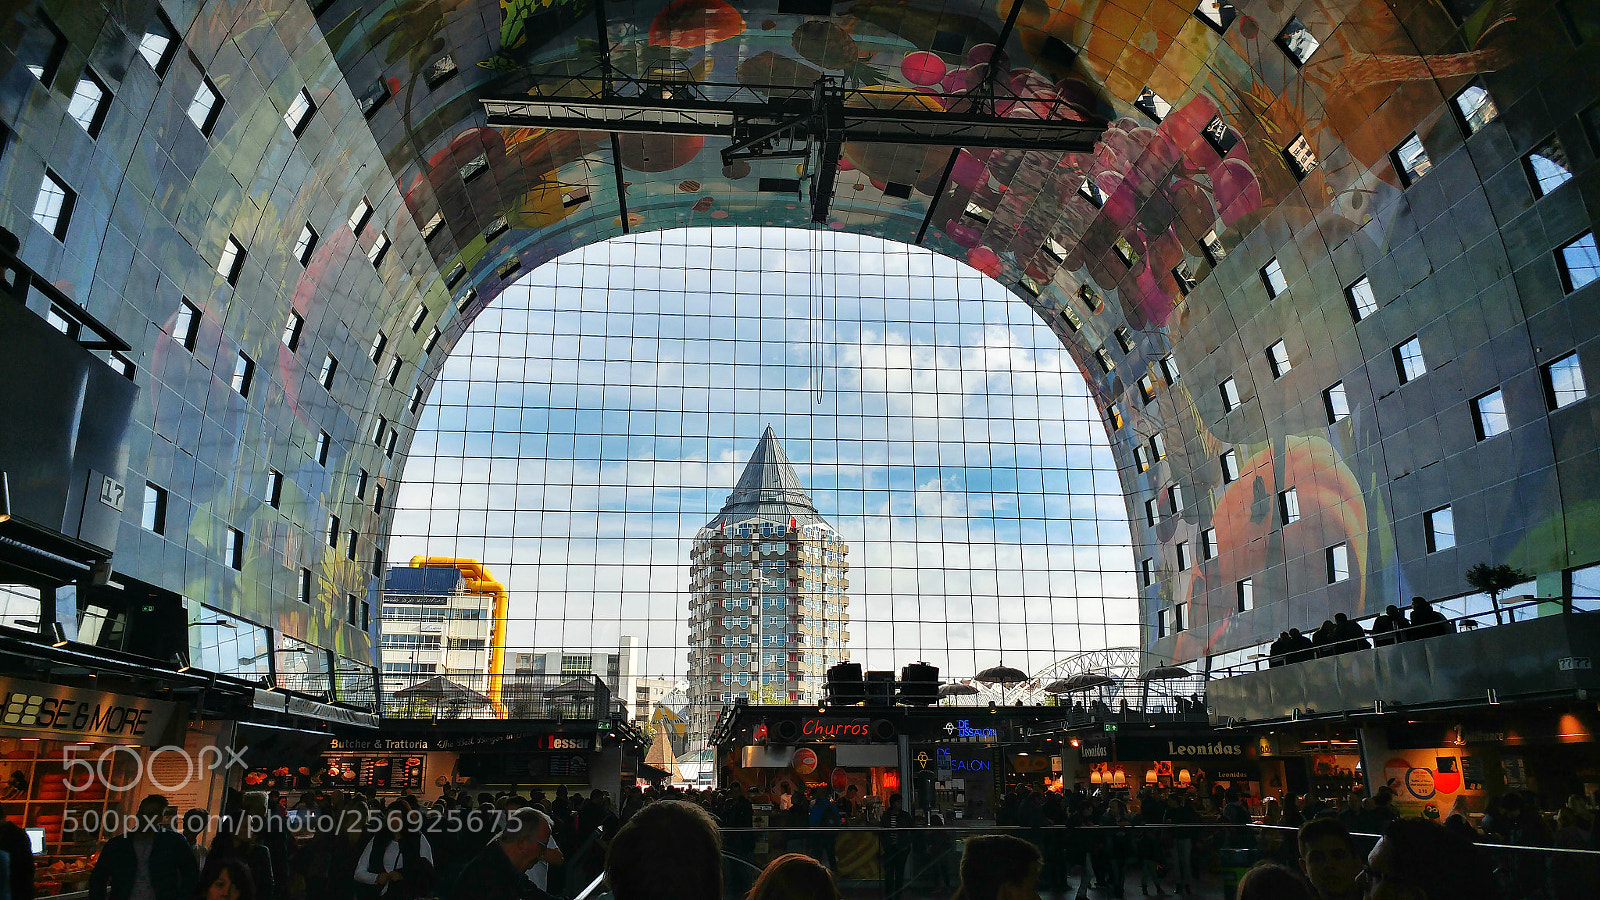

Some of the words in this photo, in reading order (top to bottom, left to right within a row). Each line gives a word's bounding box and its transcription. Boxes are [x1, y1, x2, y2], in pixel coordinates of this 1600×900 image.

[102, 480, 124, 505] 17
[73, 703, 89, 729] &
[89, 704, 152, 735] MORE
[958, 719, 969, 728] DE
[802, 719, 869, 735] Churros
[331, 739, 371, 749] Butcher
[374, 739, 382, 749] &
[385, 739, 428, 749] Trattoria
[1168, 741, 1242, 756] Leonidas
